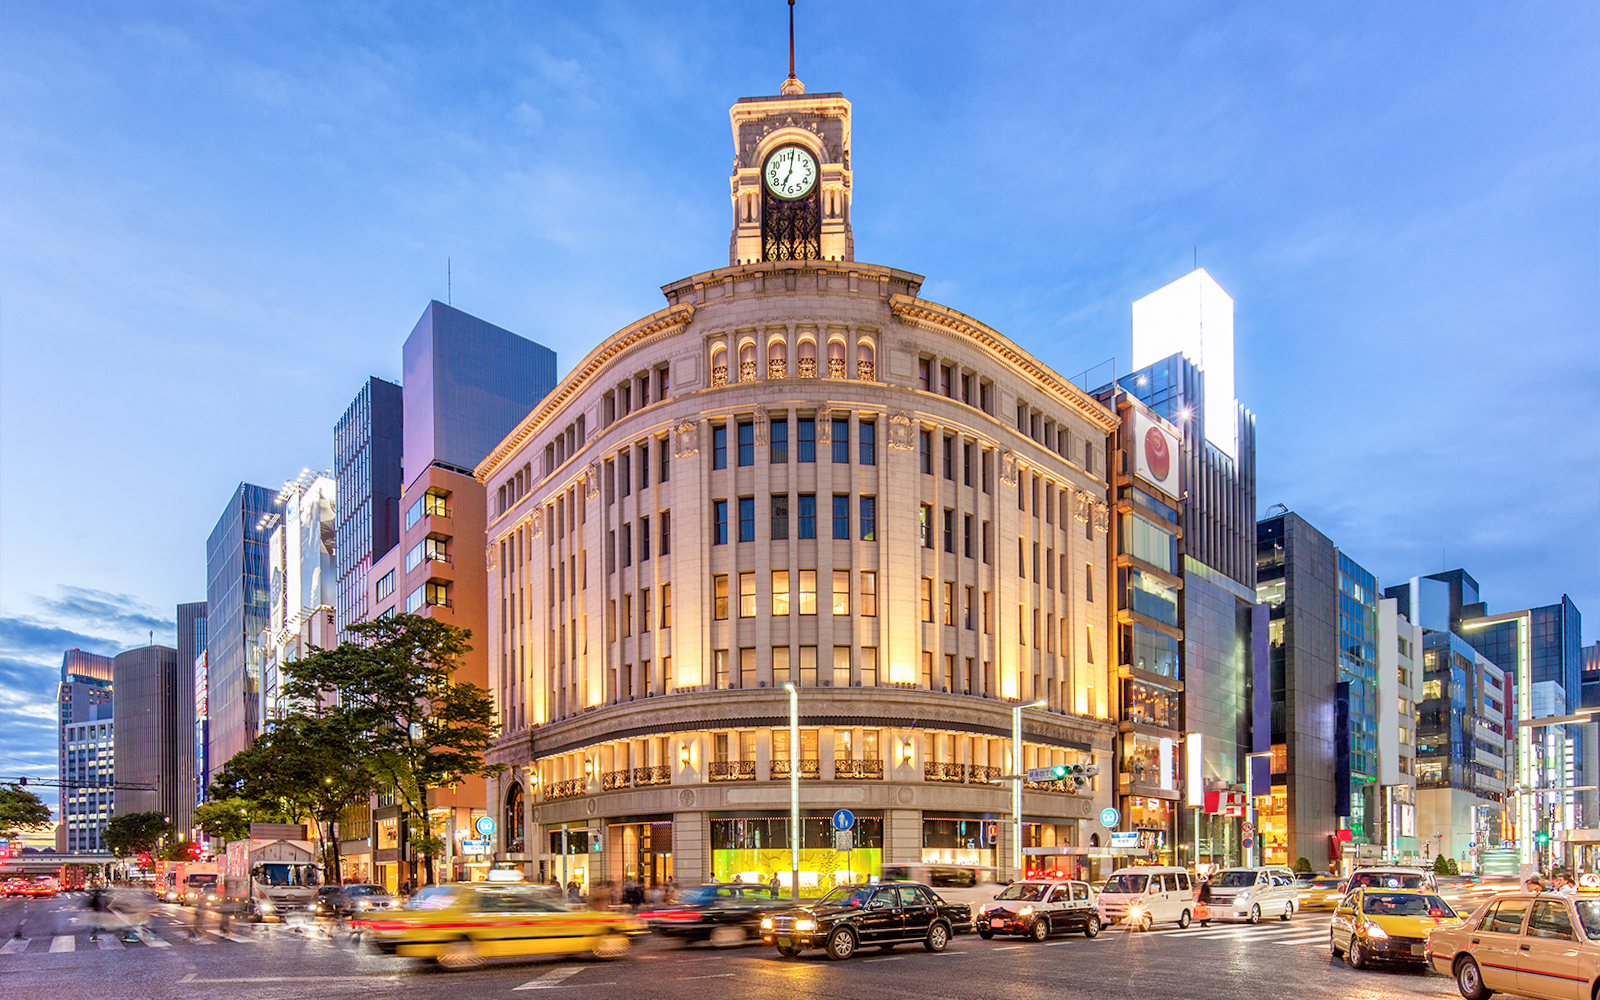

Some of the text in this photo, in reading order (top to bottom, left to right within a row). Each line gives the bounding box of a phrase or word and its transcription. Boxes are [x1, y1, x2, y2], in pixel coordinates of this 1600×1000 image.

[780, 154, 786, 162] 11
[787, 152, 794, 160] 12
[797, 154, 801, 162] 1
[773, 161, 780, 169] 10
[802, 159, 809, 167] 2
[770, 170, 777, 178] 9
[805, 168, 812, 176] 3
[773, 178, 779, 186] 8
[802, 177, 809, 185] 4
[780, 183, 786, 192] 7
[787, 186, 794, 194] 6
[796, 183, 802, 191] 5
